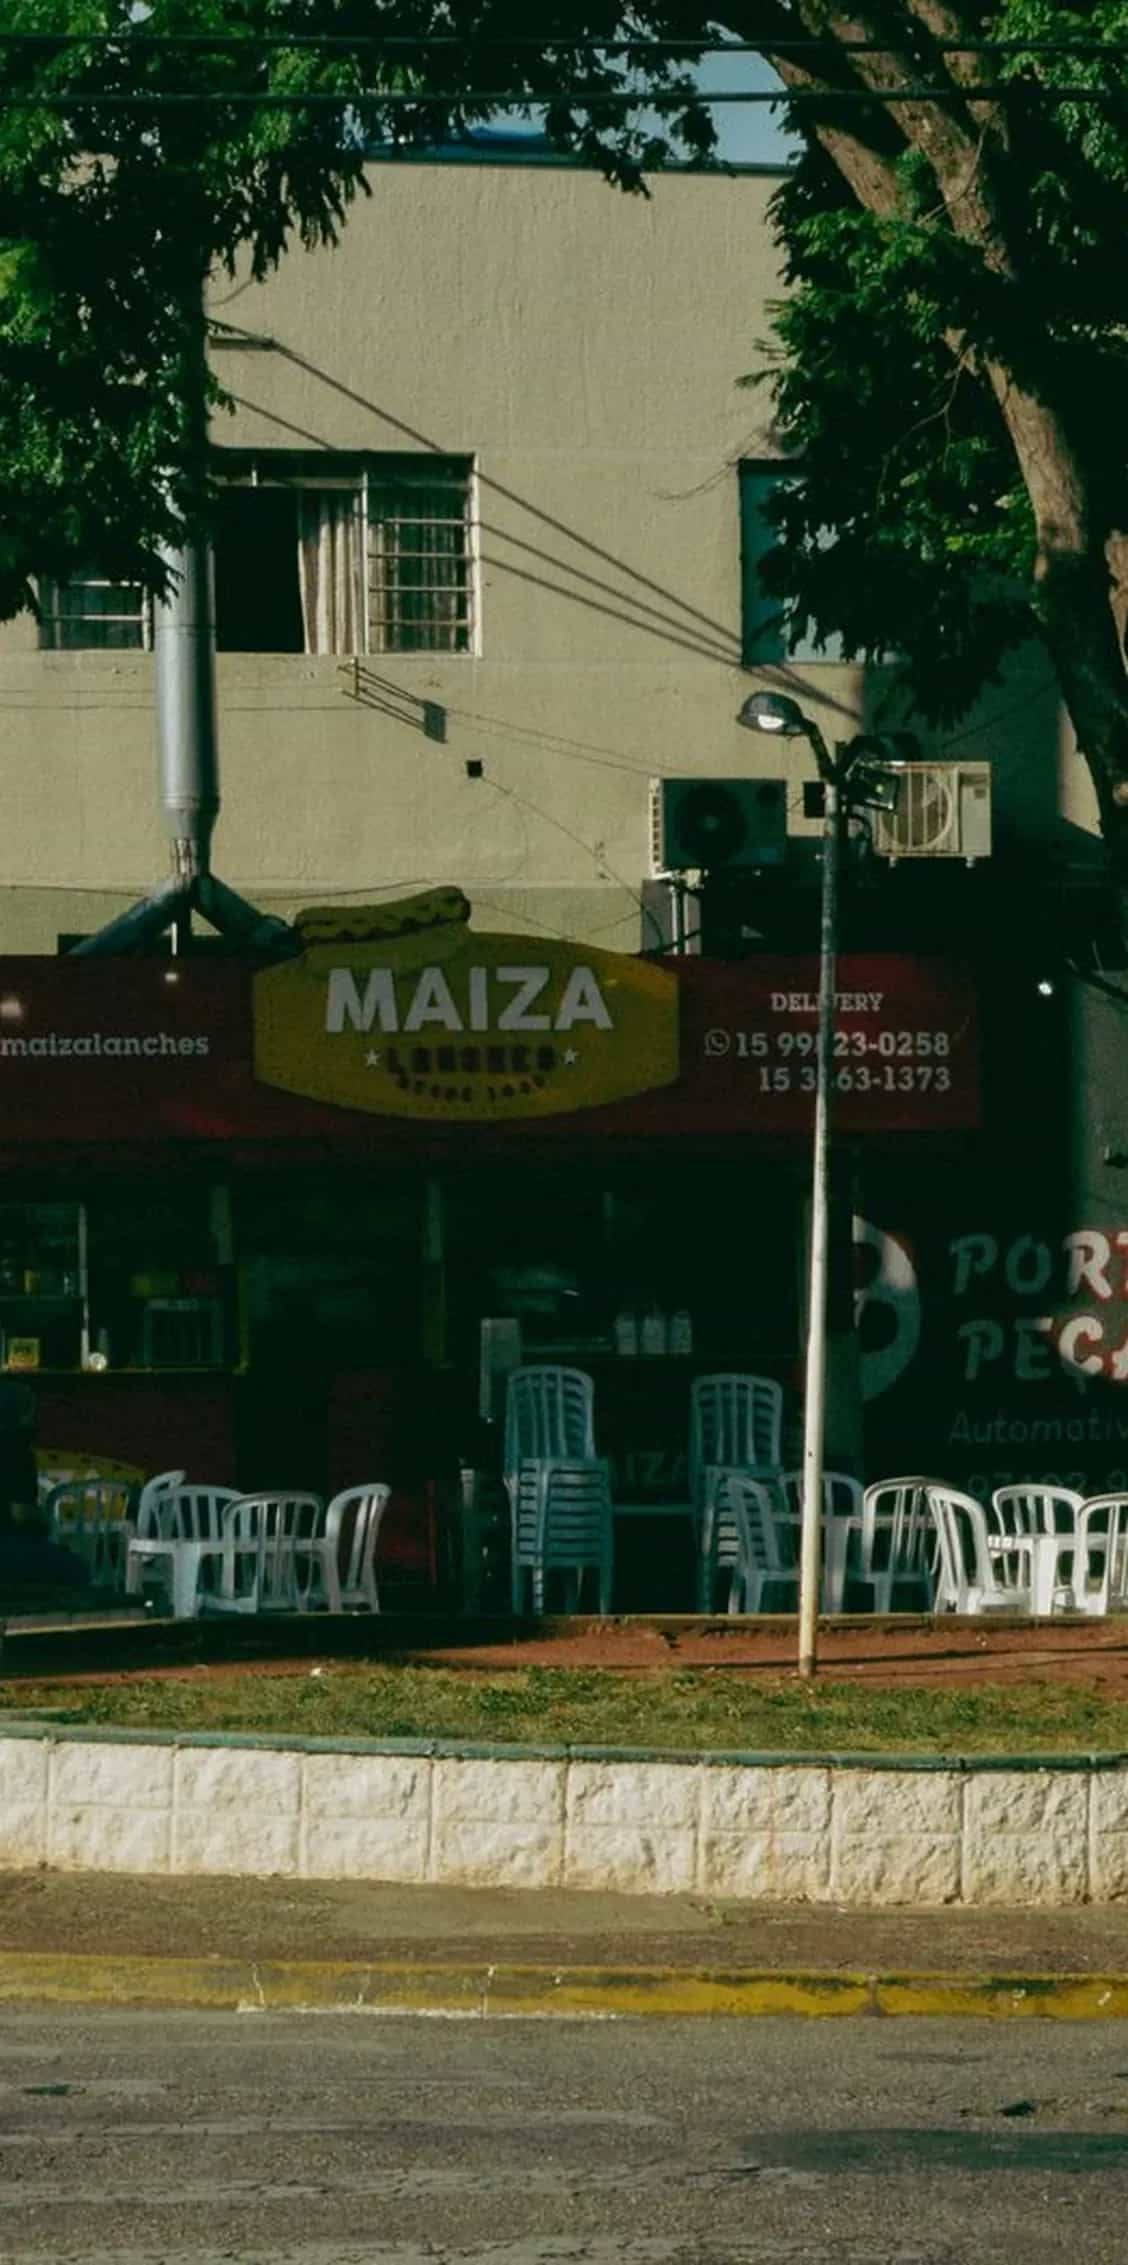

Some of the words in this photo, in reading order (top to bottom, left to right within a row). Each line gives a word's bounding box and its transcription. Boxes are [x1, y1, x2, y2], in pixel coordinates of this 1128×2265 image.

[325, 965, 614, 1033] MAIZA
[0, 1032, 210, 1056] maizalanches
[736, 1032, 768, 1057] 15
[776, 1031, 950, 1057] 9923-0258
[760, 1066, 790, 1092] 15
[800, 1066, 951, 1092] 363-1373
